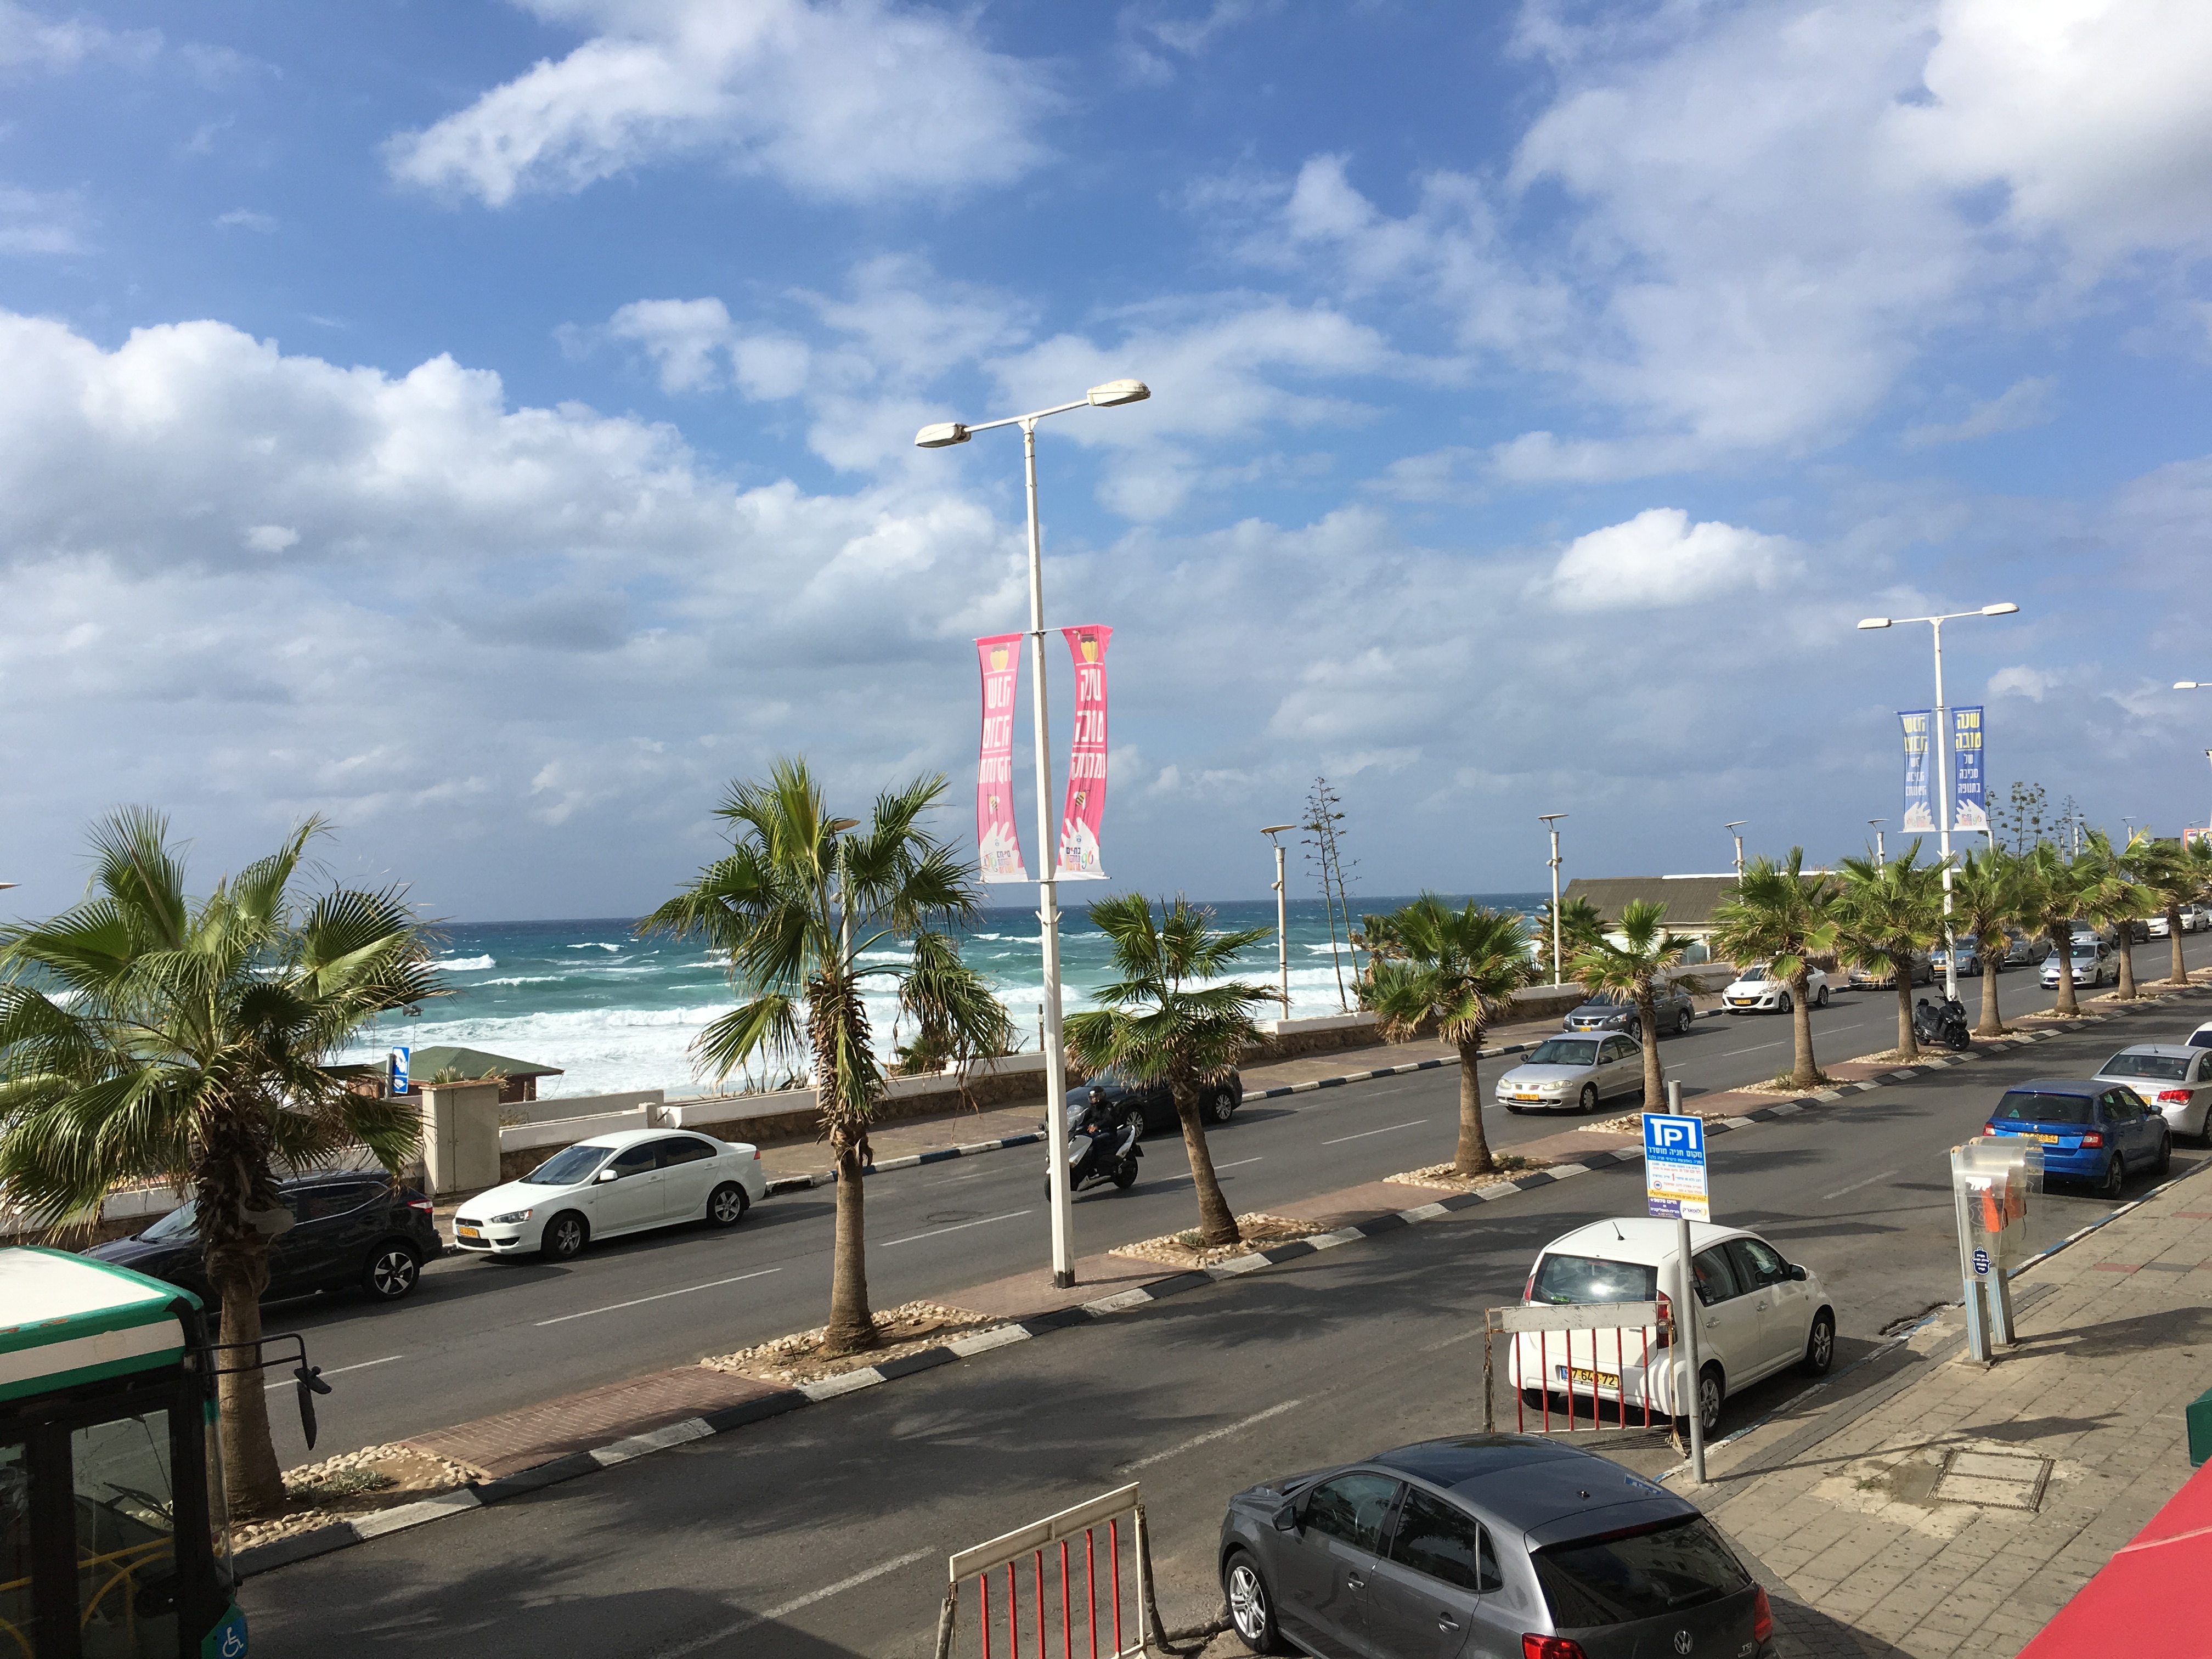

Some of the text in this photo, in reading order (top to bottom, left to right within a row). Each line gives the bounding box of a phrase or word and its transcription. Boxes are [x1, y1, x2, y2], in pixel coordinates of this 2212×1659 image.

[1075, 710, 1104, 742] טובה
[1957, 713, 1979, 730] שנה
[1955, 732, 1982, 749] טובה
[1071, 753, 1105, 780] ומתוק
[1964, 753, 1973, 764] של
[1959, 768, 1978, 779] סביבה
[1958, 782, 1980, 793] בתנופה
[1663, 1128, 1683, 1147] P
[1647, 1146, 1702, 1158] מקום חניה מוסדר
[1568, 1369, 1615, 1386] 7-64-72
[1741, 1642, 1752, 1651] TSI
